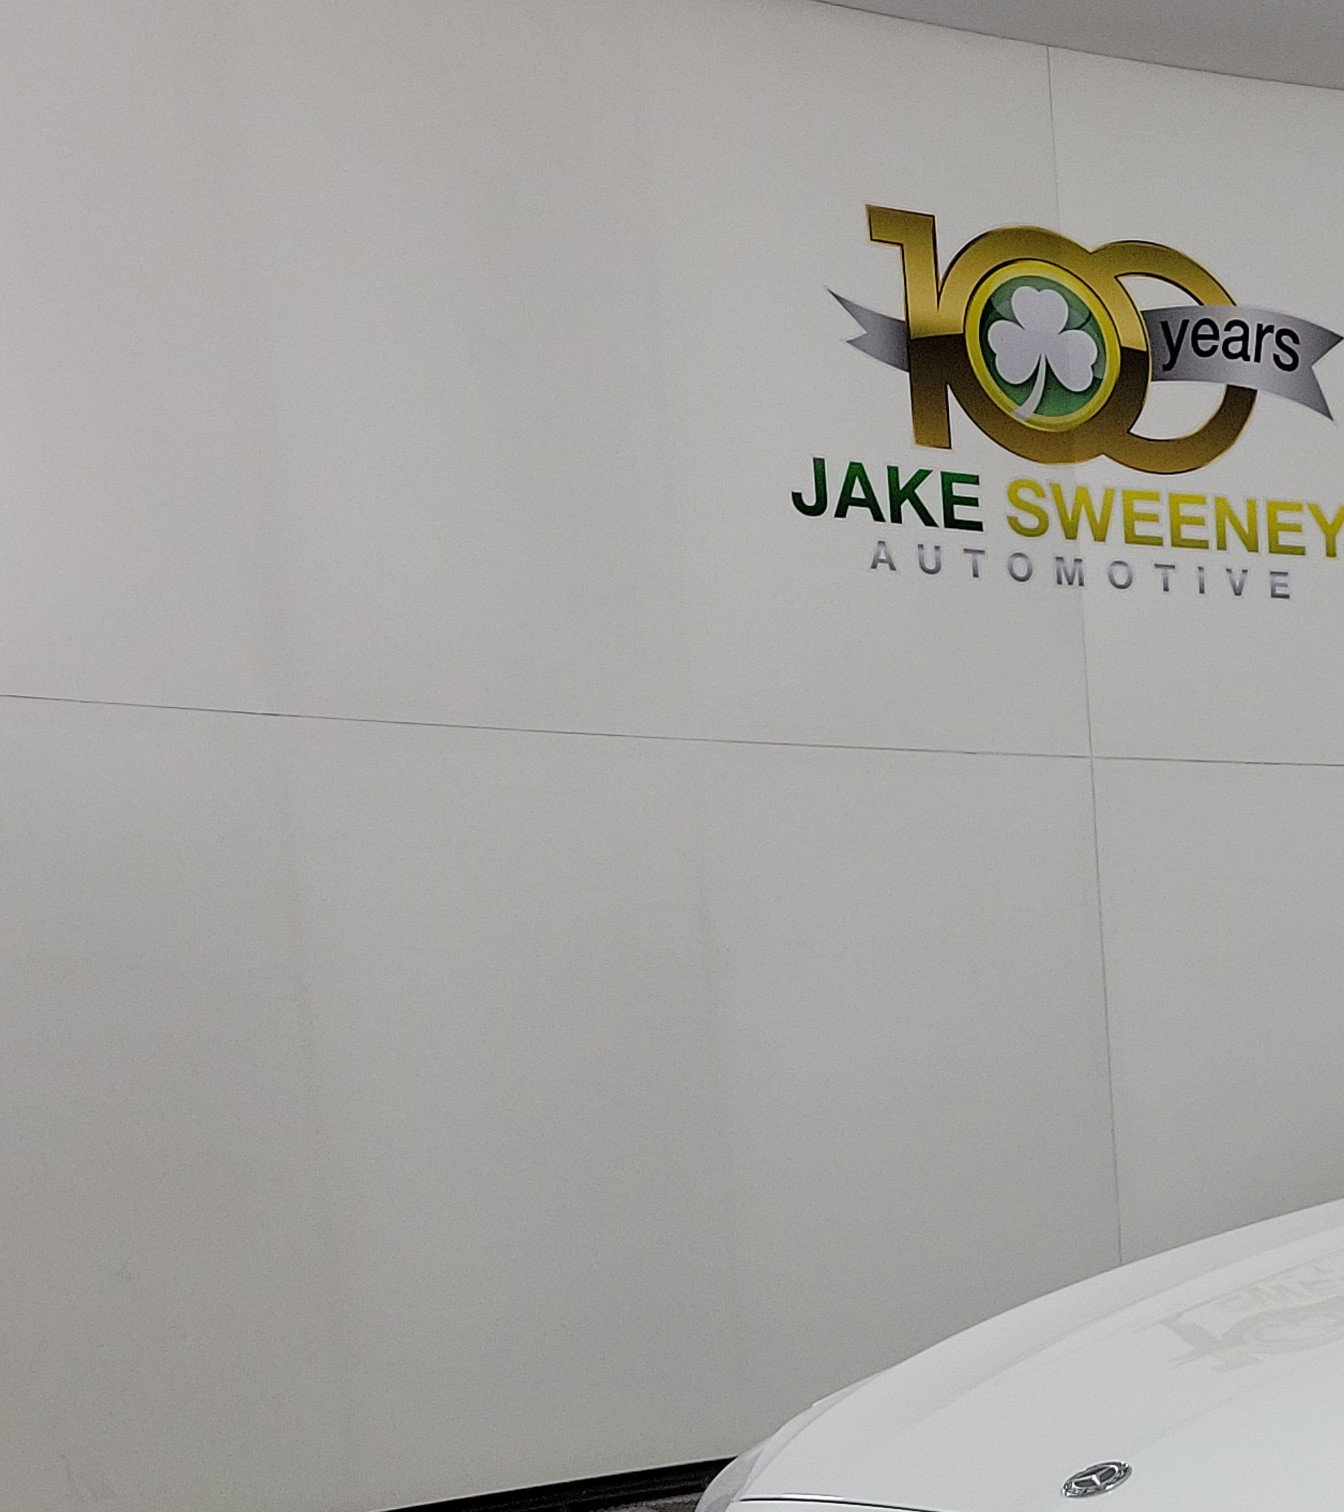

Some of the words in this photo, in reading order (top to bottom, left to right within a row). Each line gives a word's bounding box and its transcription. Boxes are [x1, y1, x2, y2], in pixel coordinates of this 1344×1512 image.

[866, 204, 1258, 475] 100
[1160, 316, 1300, 372] years
[791, 456, 984, 533] JAKE
[870, 540, 1291, 599] AUTOMOTIVE
